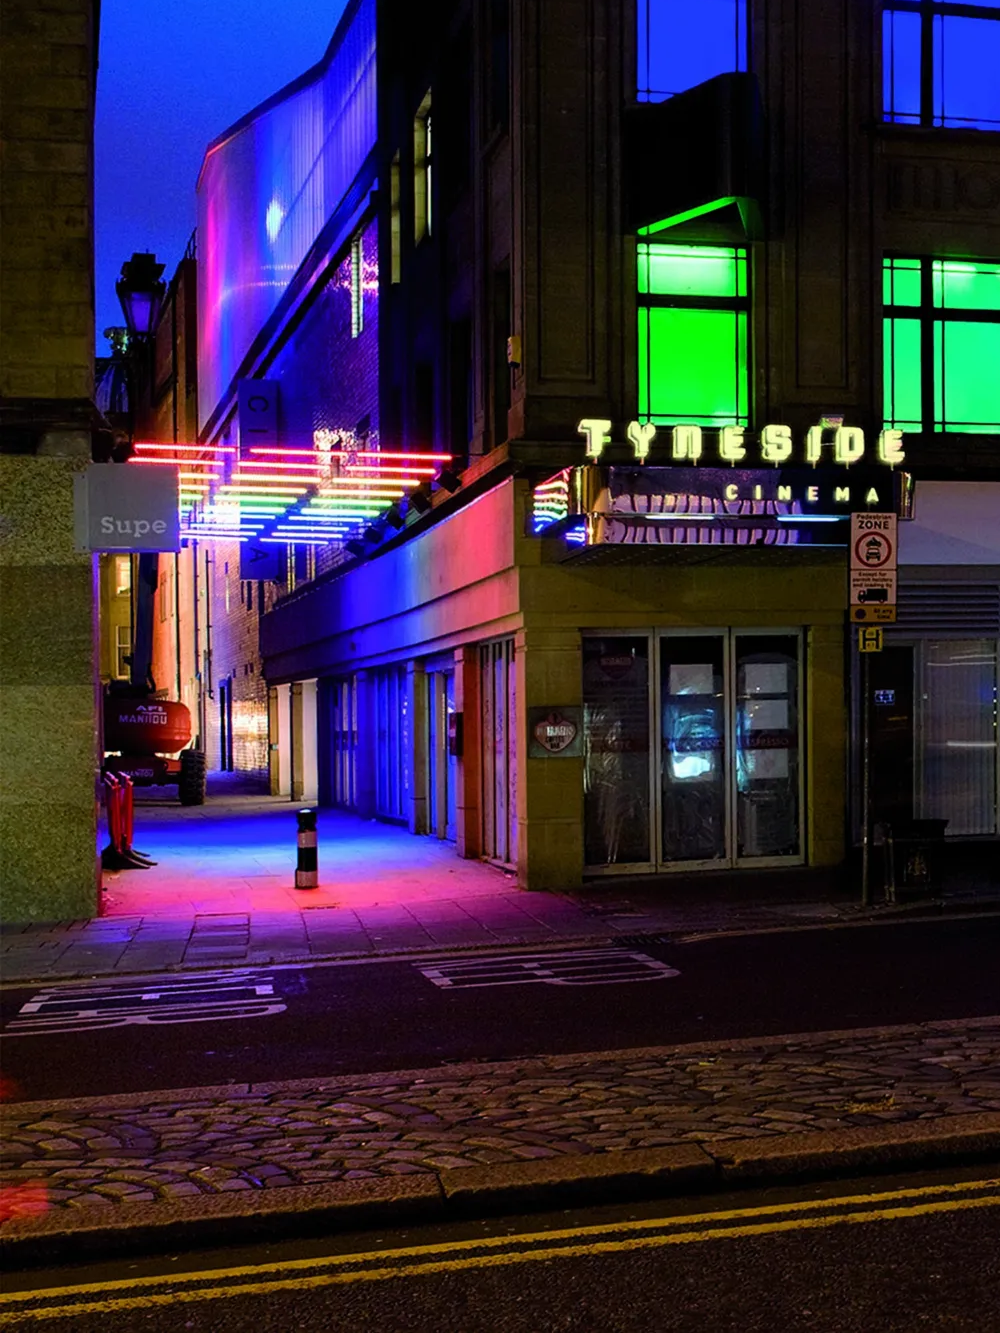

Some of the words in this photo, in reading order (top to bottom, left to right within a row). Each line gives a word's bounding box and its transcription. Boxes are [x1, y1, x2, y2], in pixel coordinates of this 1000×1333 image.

[578, 418, 905, 463] TYNESIDE
[724, 483, 880, 503] CINEMA
[101, 516, 167, 537] Supe
[858, 520, 890, 529] ZONE
[862, 629, 880, 650] H
